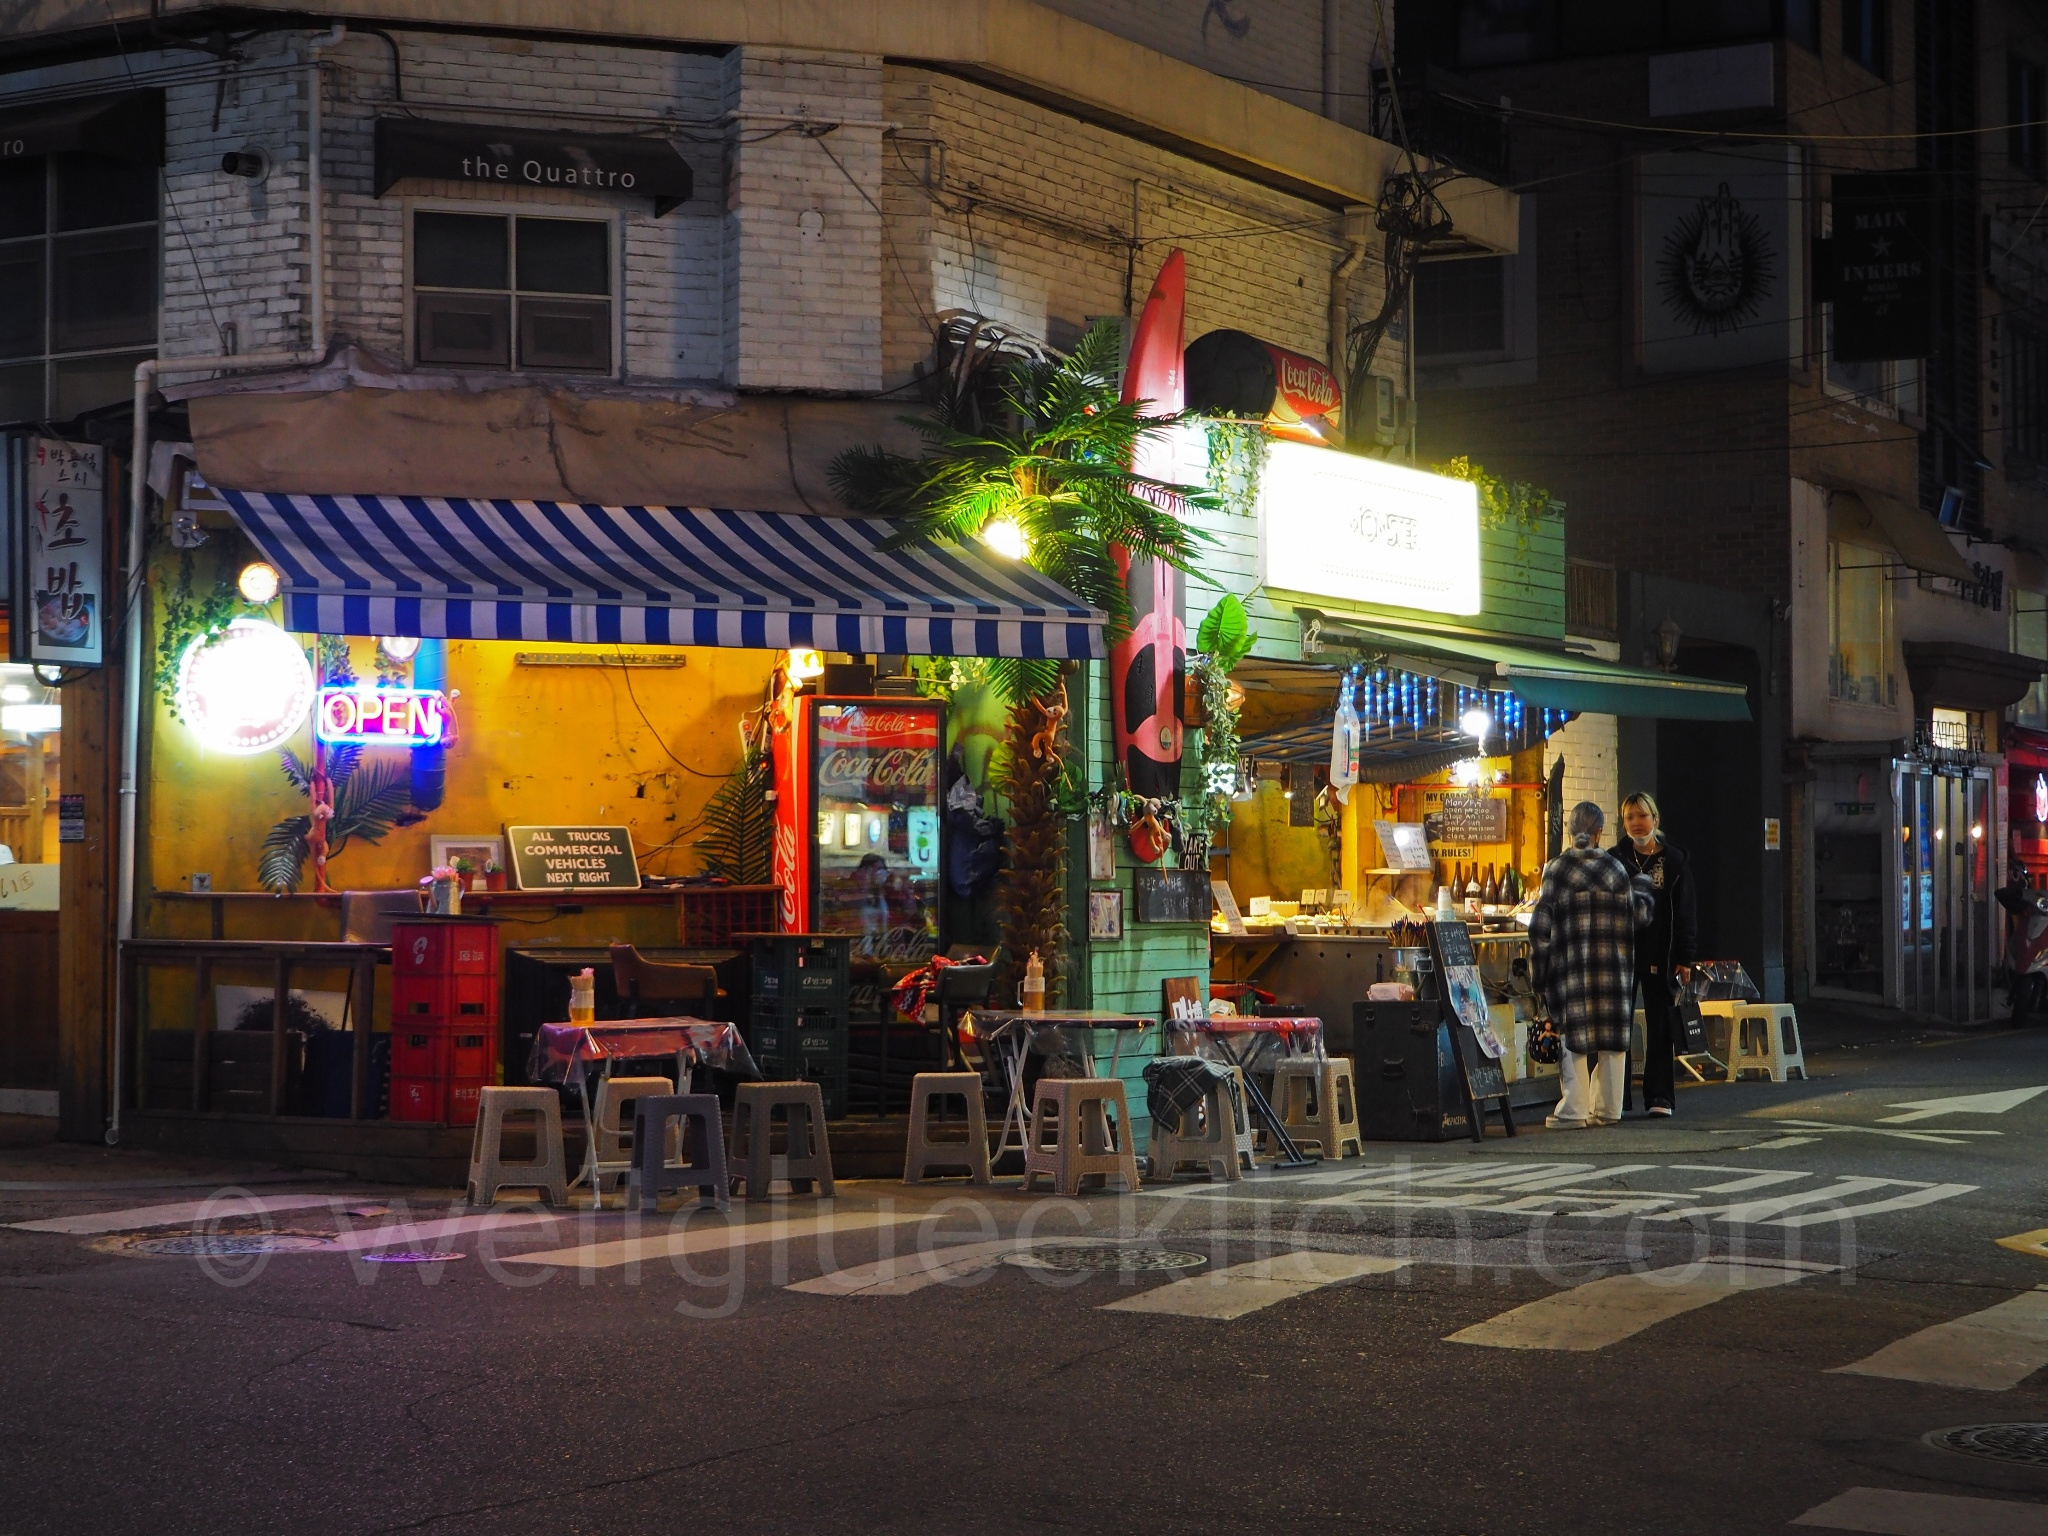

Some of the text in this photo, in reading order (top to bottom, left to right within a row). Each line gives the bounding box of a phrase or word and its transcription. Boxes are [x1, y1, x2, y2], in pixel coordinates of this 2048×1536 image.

[462, 156, 636, 188] the Quattro
[1854, 211, 1906, 229] MAIN
[1843, 261, 1922, 281] INKERS
[1281, 357, 1333, 406] Coca-Cola
[47, 492, 89, 620] 초밥
[324, 693, 438, 737] OPEN
[819, 748, 937, 787] Coca-Cola
[1426, 793, 1438, 802] MY
[532, 832, 611, 842] ALL TRUCKS
[524, 845, 622, 855] COMMERCIAL
[1442, 848, 1471, 857] RULES!
[545, 858, 607, 869] VEHICLES
[1184, 854, 1200, 870] OUT
[546, 872, 610, 883] NEXT RIGHT
